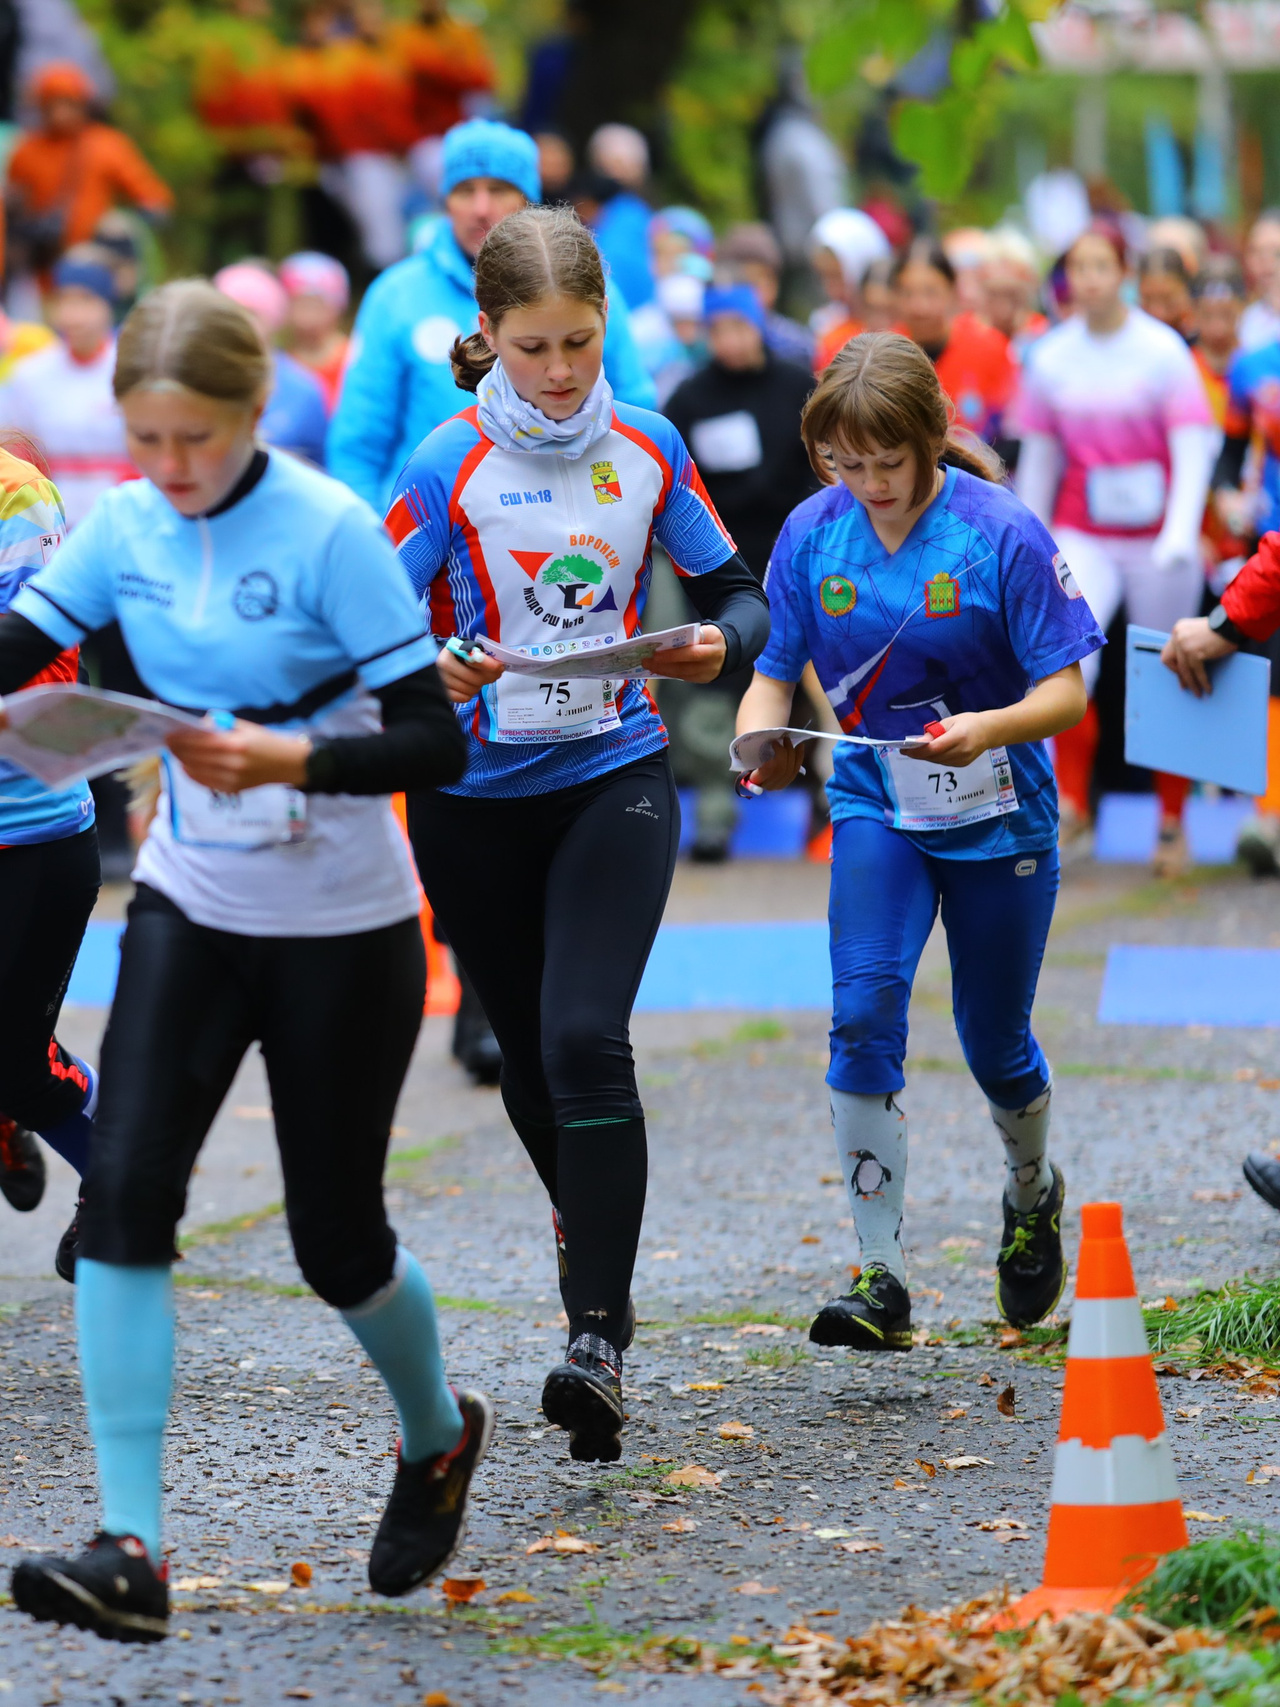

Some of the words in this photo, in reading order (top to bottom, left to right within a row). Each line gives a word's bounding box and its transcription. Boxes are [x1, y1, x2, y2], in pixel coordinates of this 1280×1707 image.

[500, 492, 523, 506] СШ
[523, 489, 553, 504] №18
[42, 537, 53, 546] 34
[569, 533, 621, 569] ВОРОНЕЖ
[523, 586, 545, 616] МБУДО
[542, 613, 561, 628] СШ
[562, 615, 584, 630] №18
[538, 680, 571, 705] 75
[555, 708, 563, 717] 4
[498, 729, 536, 737] ПЕРВЕНСТВО
[548, 729, 593, 742] СОРЕВНОВАНИЯ
[927, 771, 958, 794] 73
[946, 796, 953, 804] 4
[625, 806, 660, 820] DEMIX
